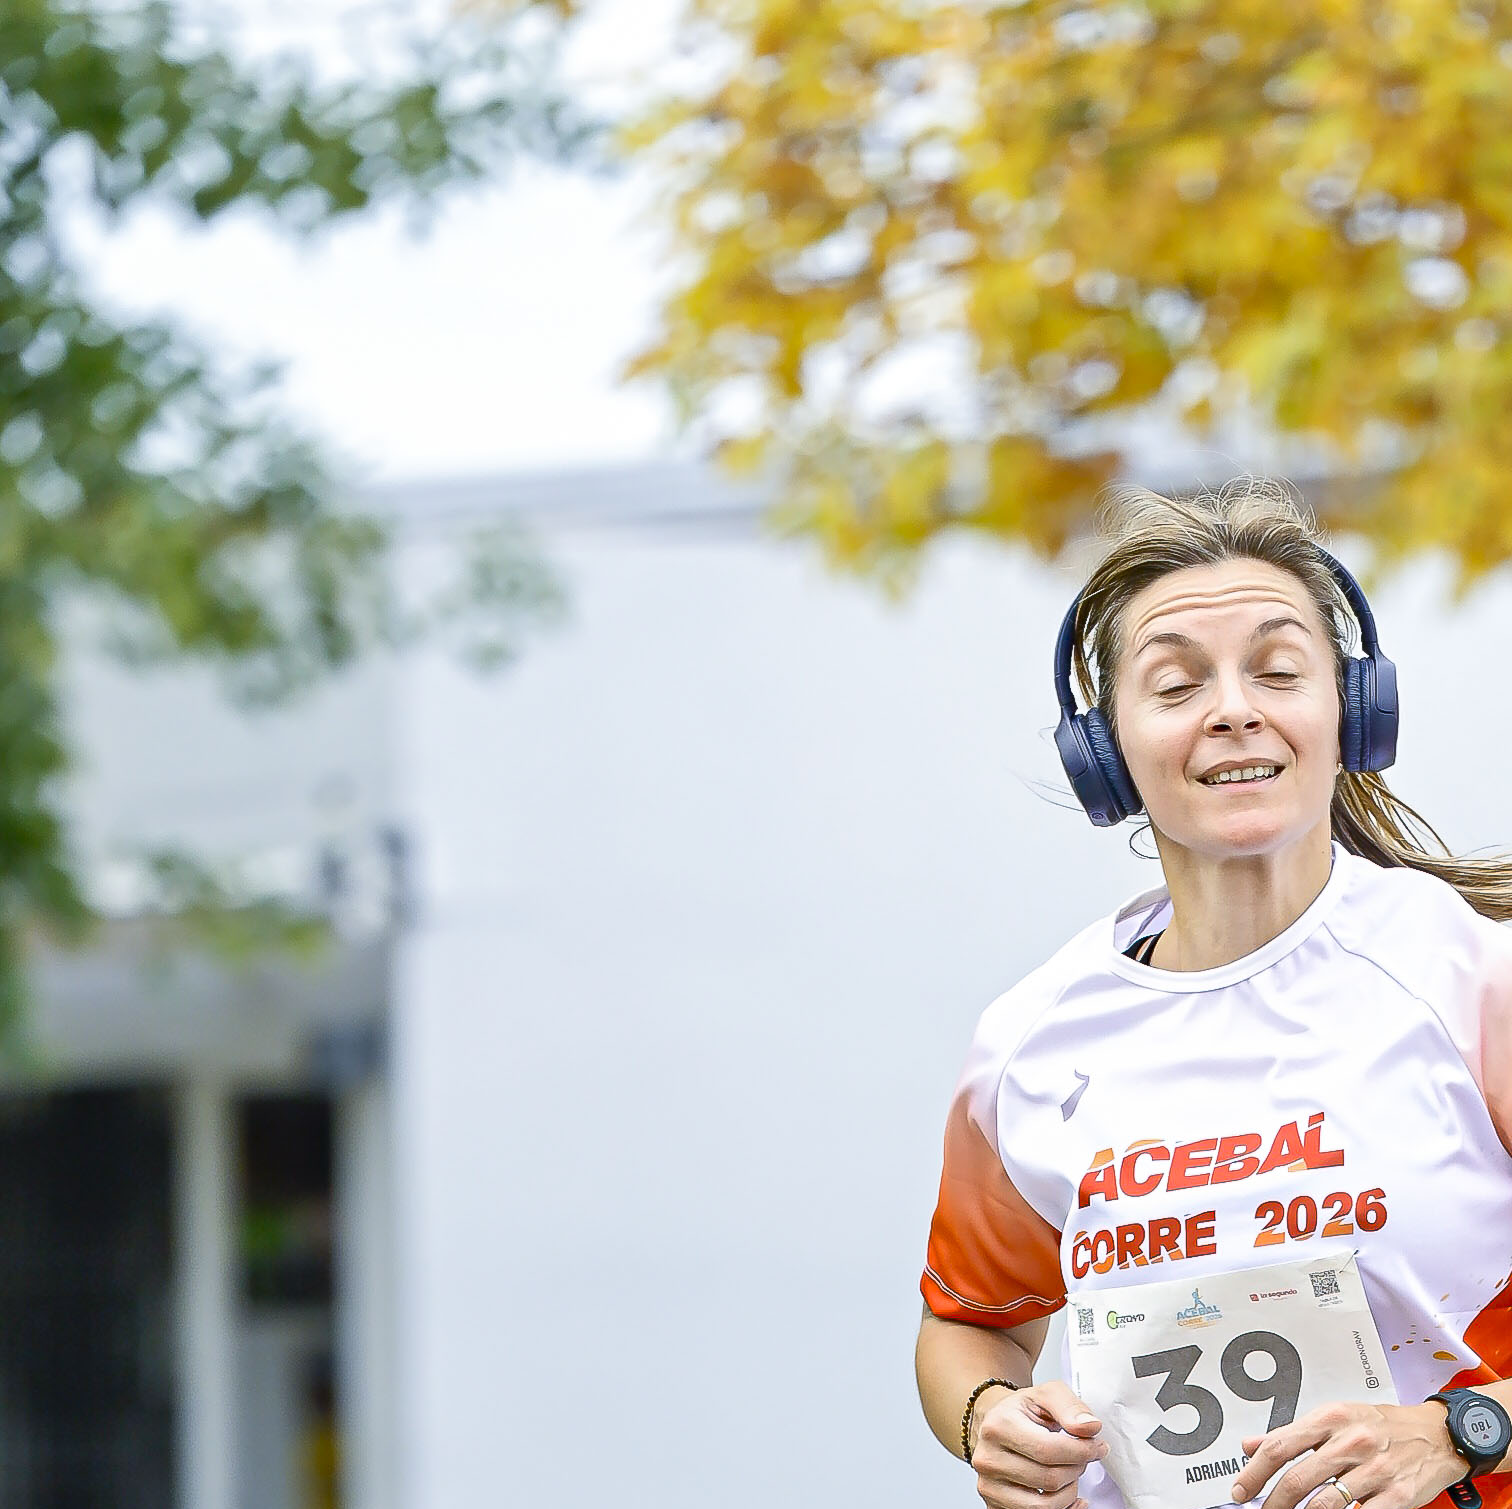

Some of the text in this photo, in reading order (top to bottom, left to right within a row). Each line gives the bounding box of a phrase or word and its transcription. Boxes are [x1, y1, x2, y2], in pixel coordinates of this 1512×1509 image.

[1078, 1112, 1345, 1209] ACEBAL
[1071, 1188, 1388, 1279] CORRE 2026
[1131, 1329, 1303, 1456] 39
[1471, 1418, 1493, 1434] 180
[1185, 1457, 1241, 1485] ADRIANA
